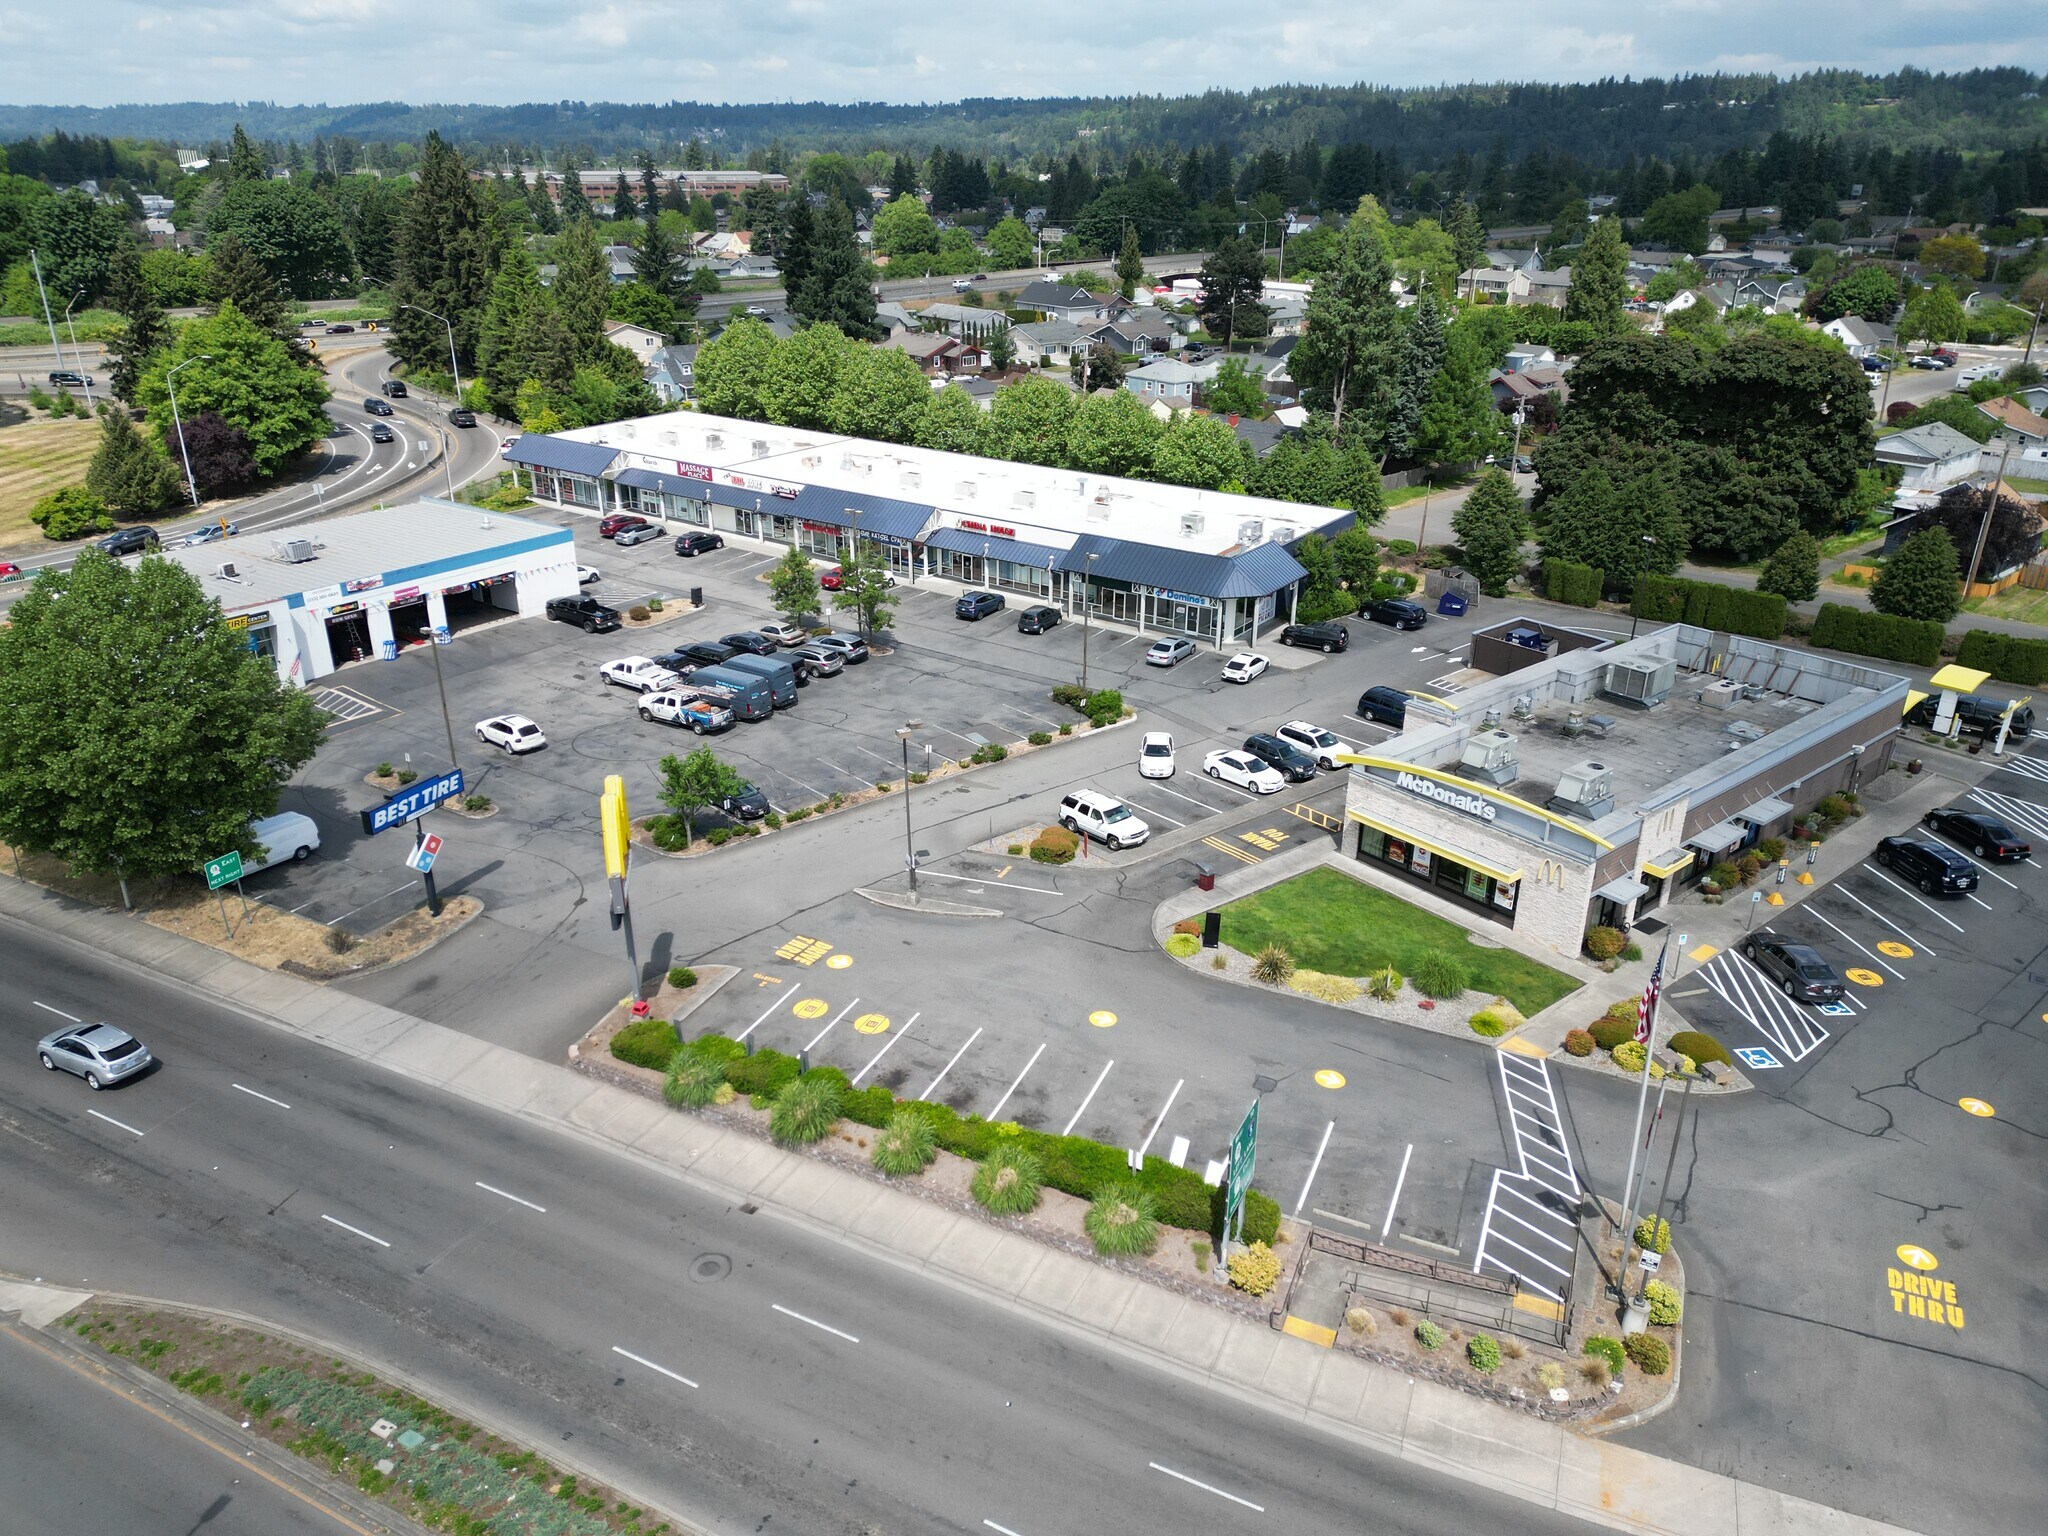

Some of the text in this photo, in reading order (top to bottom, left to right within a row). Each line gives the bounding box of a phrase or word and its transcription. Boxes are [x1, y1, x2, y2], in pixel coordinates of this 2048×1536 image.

[680, 462, 709, 478] MASSAGE
[990, 525, 1016, 537] HOUSE
[247, 614, 268, 624] CENTER
[374, 794, 420, 829] BEST
[421, 774, 460, 804] TIRE
[1396, 771, 1496, 820] McDonald's
[210, 868, 241, 886] NEXT RIGHT
[775, 935, 816, 960] THRU
[793, 939, 834, 966] DRIVE
[1887, 1267, 1958, 1305] DRIVE
[1890, 1289, 1965, 1329] THRU
